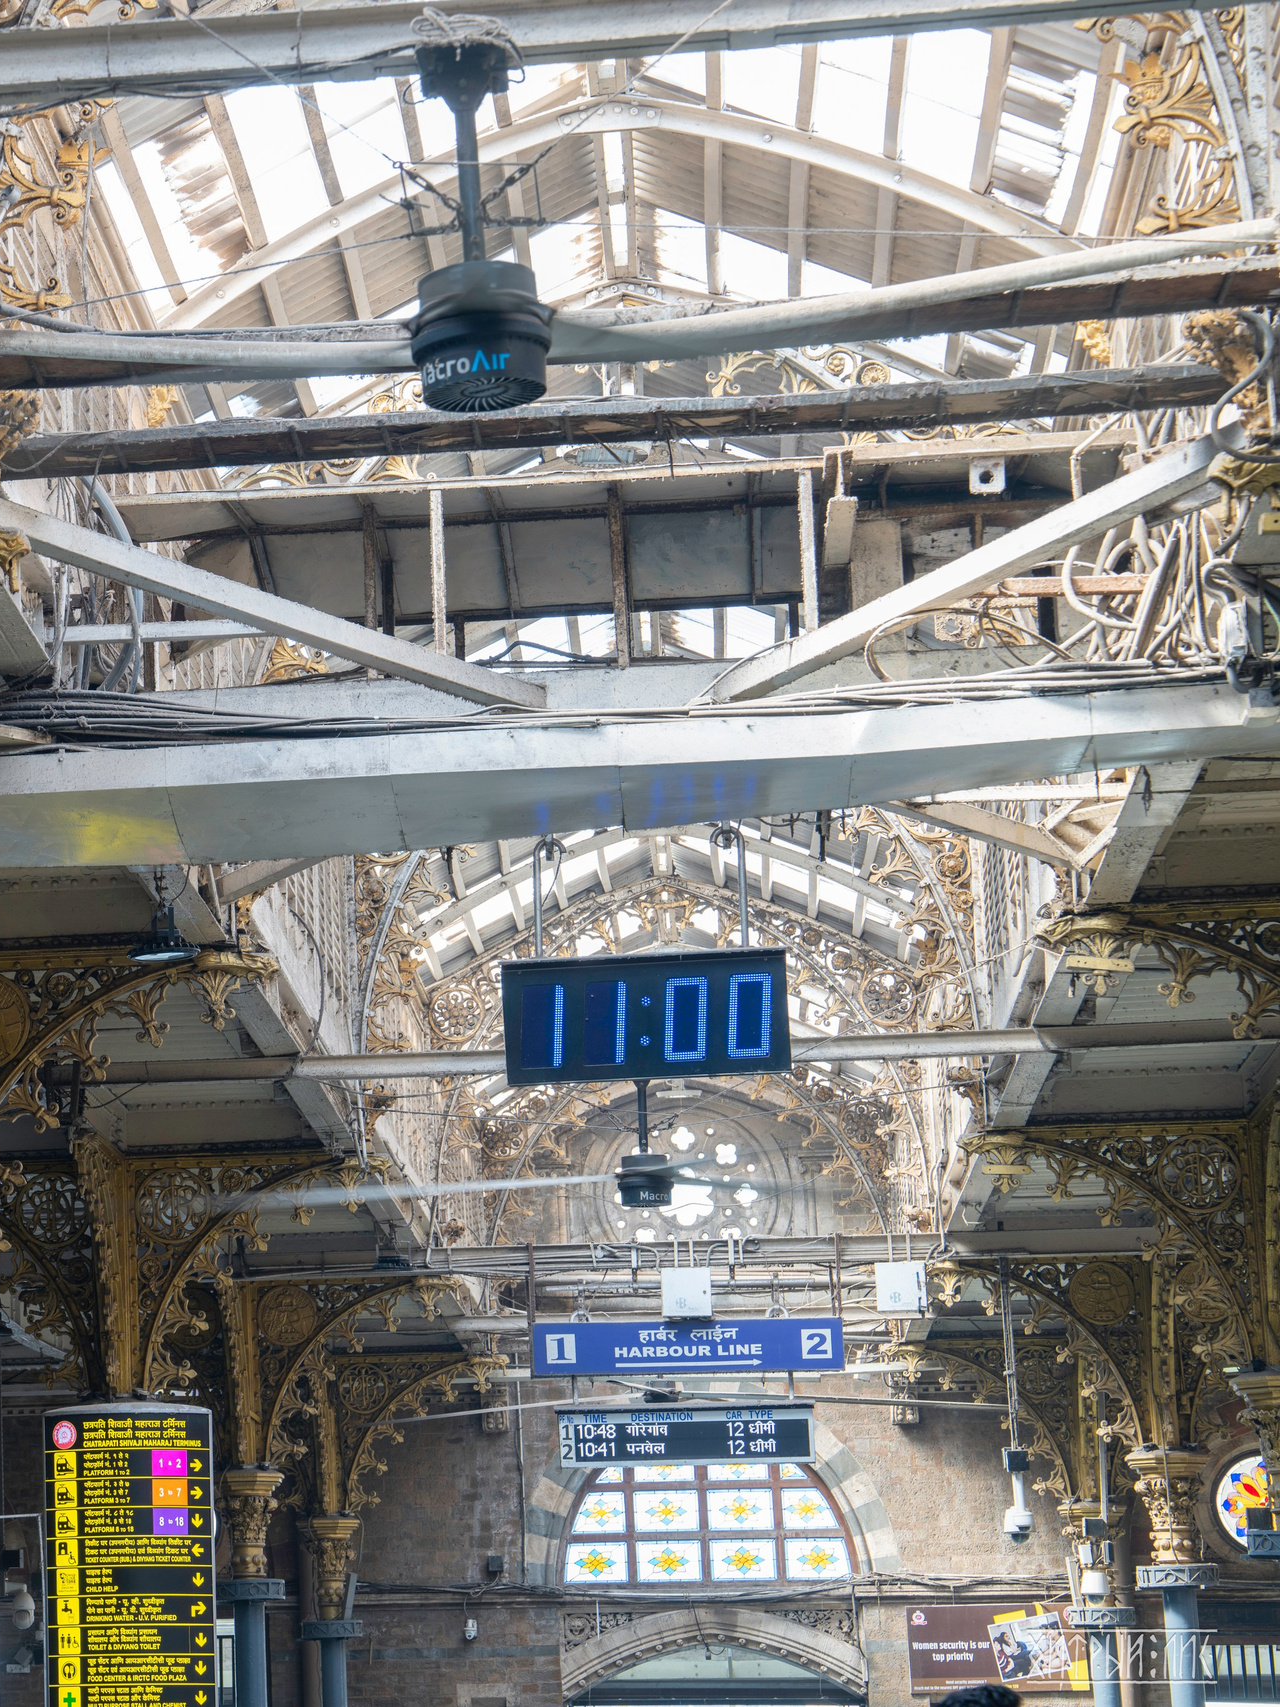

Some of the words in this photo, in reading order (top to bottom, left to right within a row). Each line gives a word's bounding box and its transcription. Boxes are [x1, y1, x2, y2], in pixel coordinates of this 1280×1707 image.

[552, 972, 772, 1068] 11:00
[639, 1326, 678, 1343] हार्बर
[690, 1327, 738, 1342] लाईन
[551, 1337, 572, 1360] 1
[614, 1345, 711, 1358] HARBOUR
[718, 1344, 762, 1356] LINE
[806, 1332, 827, 1356] 2
[583, 1414, 607, 1423] TIME
[631, 1412, 693, 1422] DESTINATION
[726, 1411, 743, 1420] CAR
[748, 1409, 773, 1419] TYPE
[83, 1419, 106, 1429] छत्रपति
[108, 1418, 133, 1428] शिवाजी
[135, 1420, 160, 1428] महाराज
[163, 1418, 186, 1428] टर्मिनस
[577, 1423, 616, 1439] 10:48
[726, 1422, 744, 1437] 12
[748, 1421, 775, 1436] धीमी
[83, 1429, 106, 1439] छत्रपति
[108, 1429, 133, 1438] शिवाजी
[135, 1430, 160, 1438] महाराज
[163, 1429, 186, 1438] टर्मिनस
[562, 1425, 572, 1440] 1
[173, 1439, 201, 1447] TERMINUS
[577, 1442, 616, 1458] 10:41
[626, 1442, 665, 1456] पनवेल
[727, 1440, 745, 1455] 12
[750, 1438, 776, 1454] धीमी
[562, 1445, 574, 1460] 2
[159, 1459, 163, 1468] 1
[176, 1459, 181, 1468] 2
[159, 1488, 164, 1497] 3
[176, 1488, 181, 1497] 7
[159, 1517, 164, 1526] 8
[175, 1517, 184, 1526] 18
[912, 1642, 938, 1650] Women
[940, 1641, 968, 1650] security
[970, 1641, 976, 1649] is
[978, 1641, 990, 1649] our
[932, 1652, 945, 1662] top
[946, 1652, 973, 1662] priority
